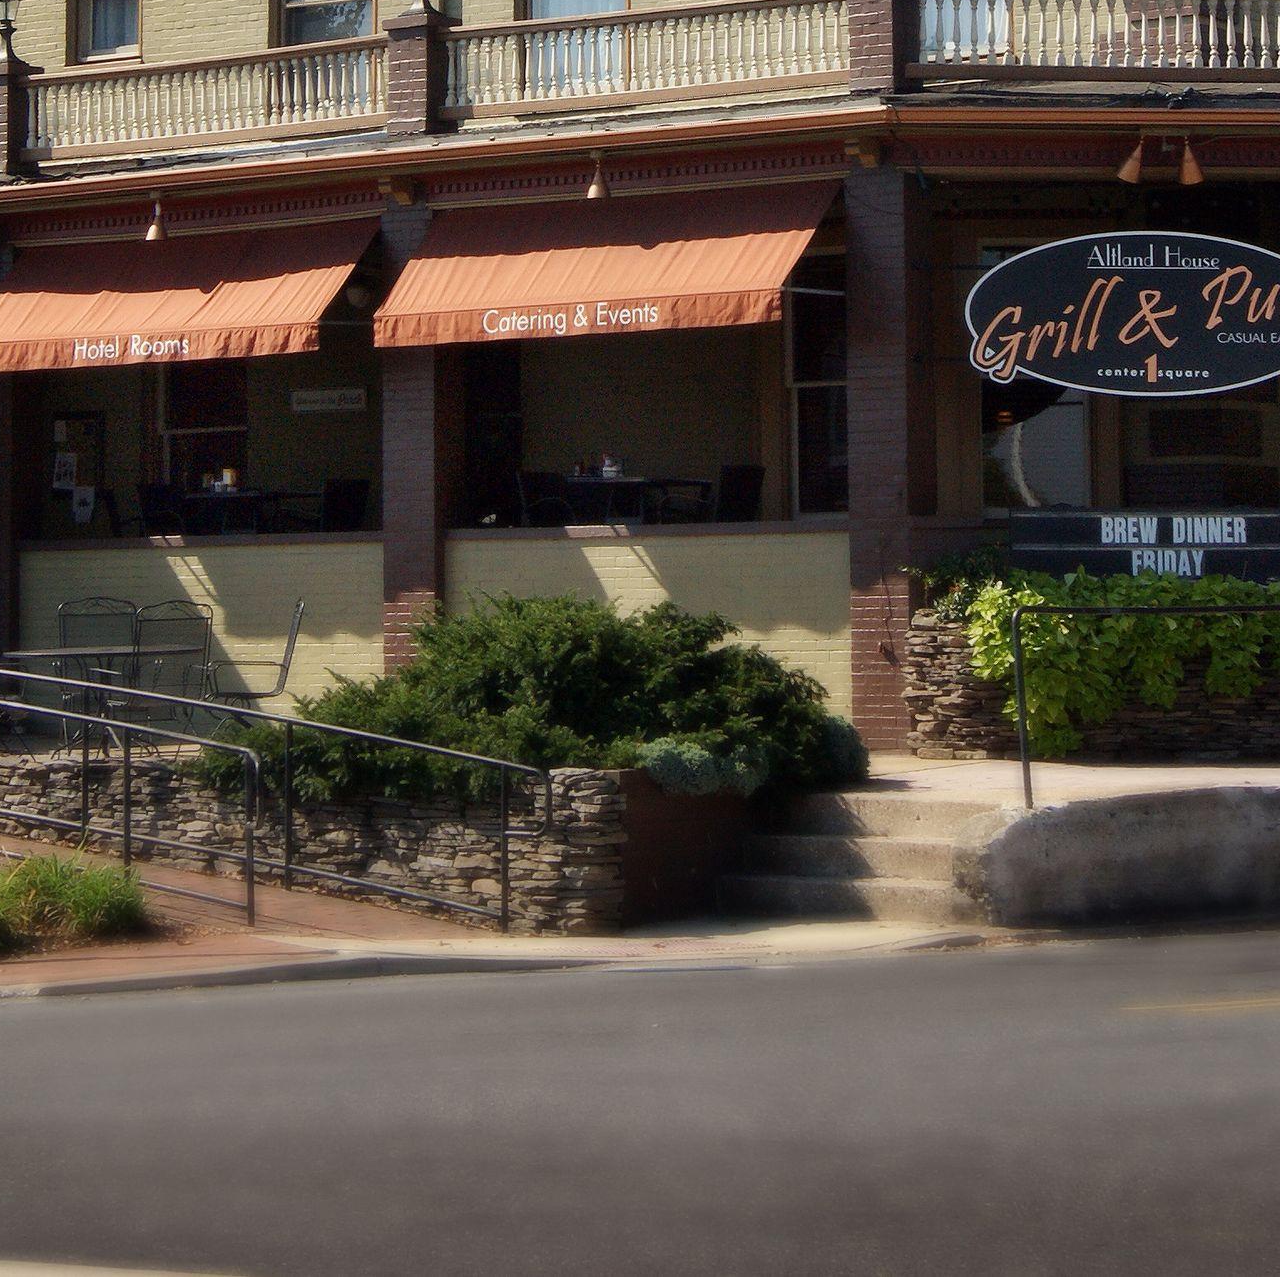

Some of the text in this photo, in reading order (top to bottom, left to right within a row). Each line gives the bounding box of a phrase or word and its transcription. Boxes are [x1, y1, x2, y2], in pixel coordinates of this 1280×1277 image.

[1087, 243, 1220, 268] Altland House
[482, 302, 659, 335] Catering & Events
[975, 275, 1125, 378] Grill
[1119, 289, 1179, 349] &
[74, 334, 189, 360] Hotel Rooms
[1216, 332, 1267, 344] CASUAL
[1097, 353, 1210, 383] center 1 square
[1101, 517, 1247, 544] BREW DINNER
[1131, 549, 1204, 577] FRIDAY
